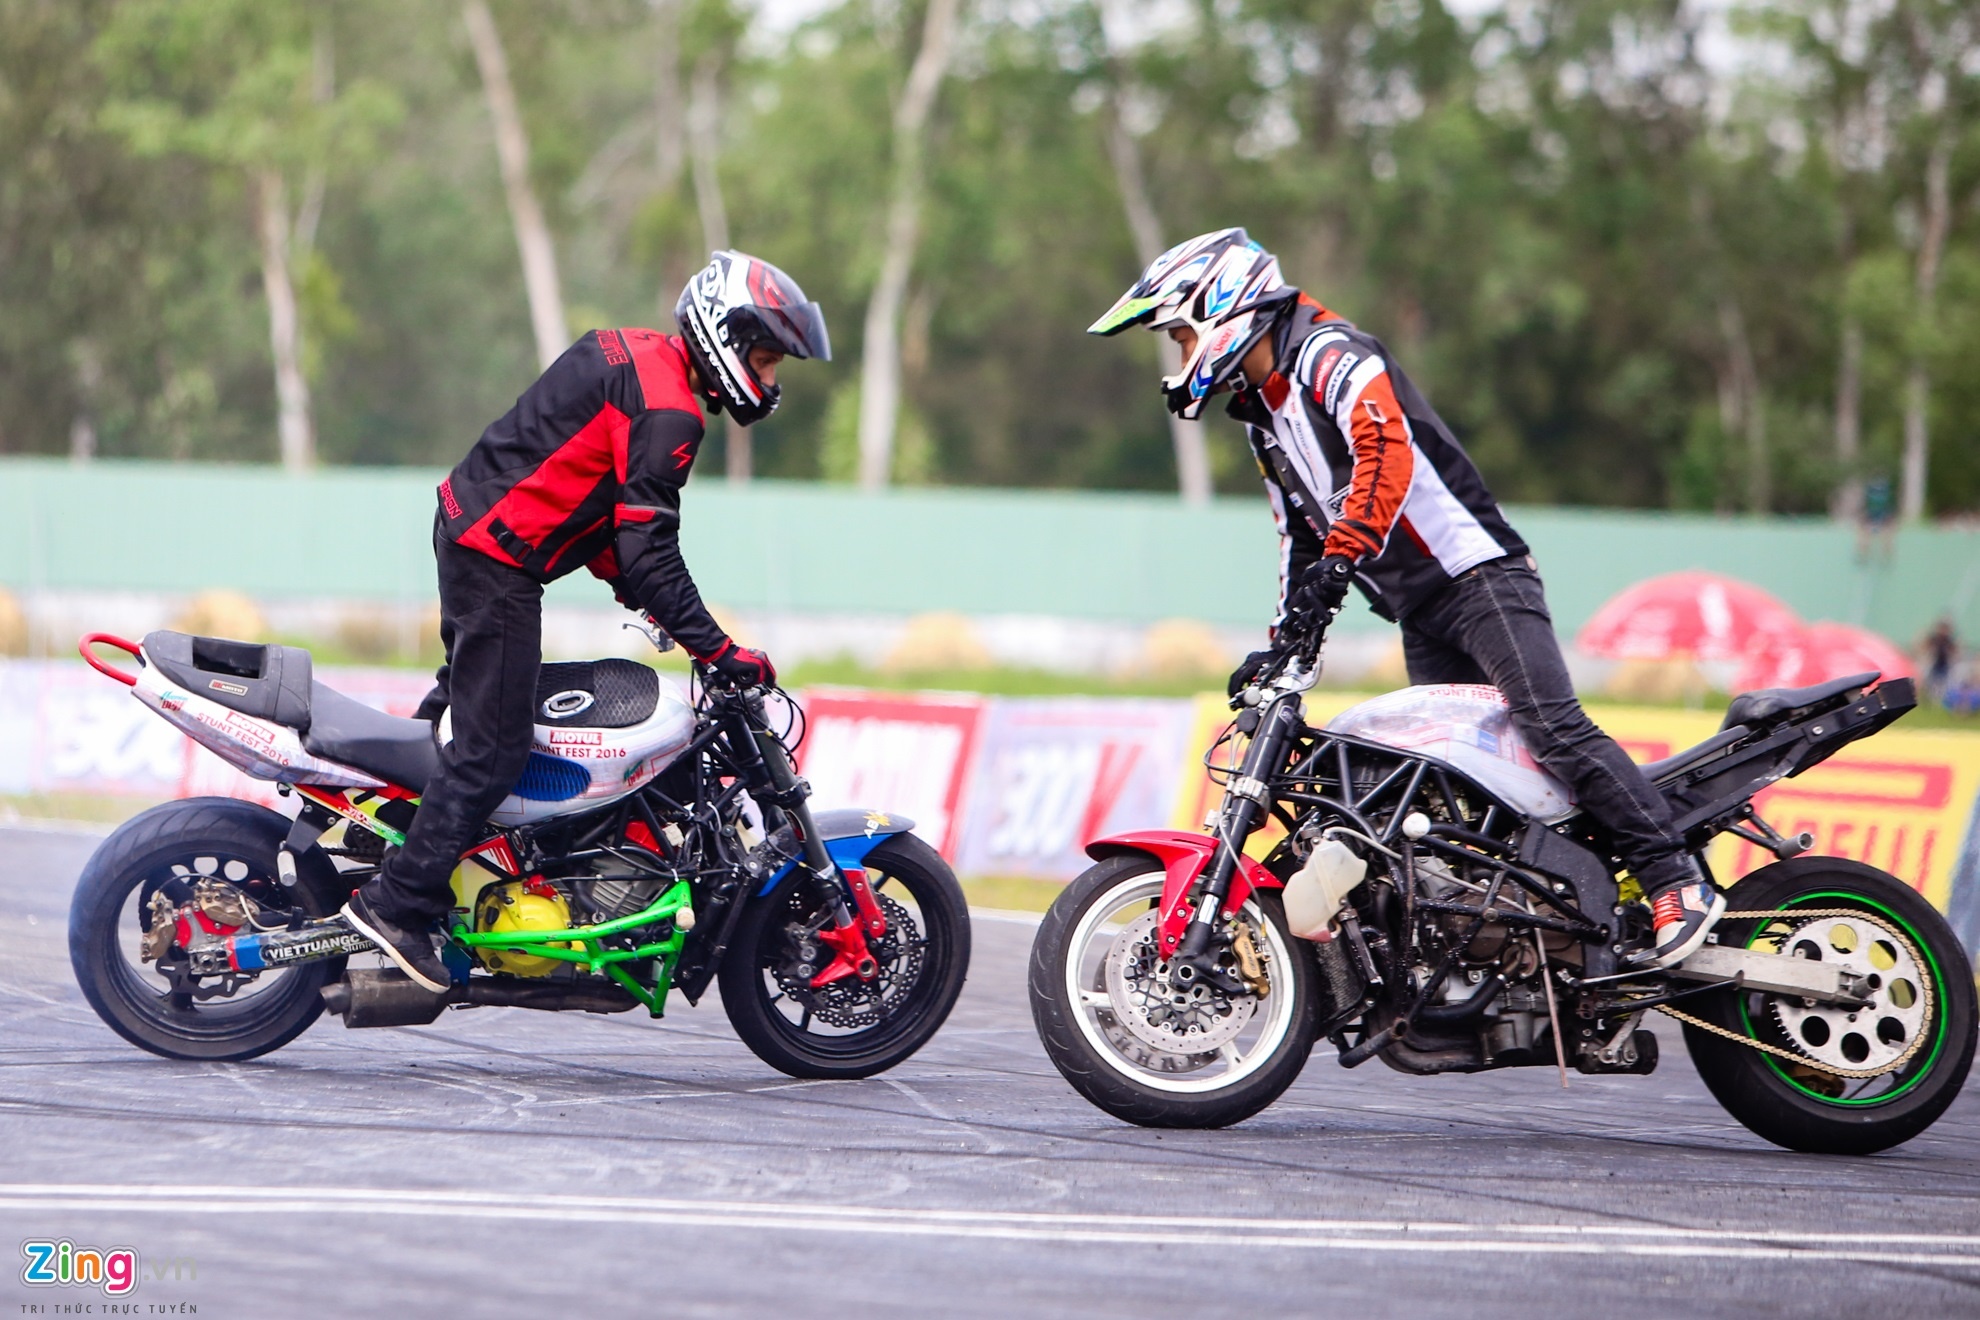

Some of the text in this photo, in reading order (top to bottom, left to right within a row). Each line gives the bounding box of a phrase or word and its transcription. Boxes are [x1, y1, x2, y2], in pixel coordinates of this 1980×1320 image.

[685, 304, 746, 407] SCORPION
[1471, 689, 1497, 701] FEST
[196, 712, 290, 767] STUNT FEST 2016
[228, 712, 273, 742] MOTUL
[551, 730, 601, 745] MOTUL
[565, 747, 592, 759] FEST
[595, 747, 627, 759] 2016
[268, 933, 361, 960] VIETTUANGC
